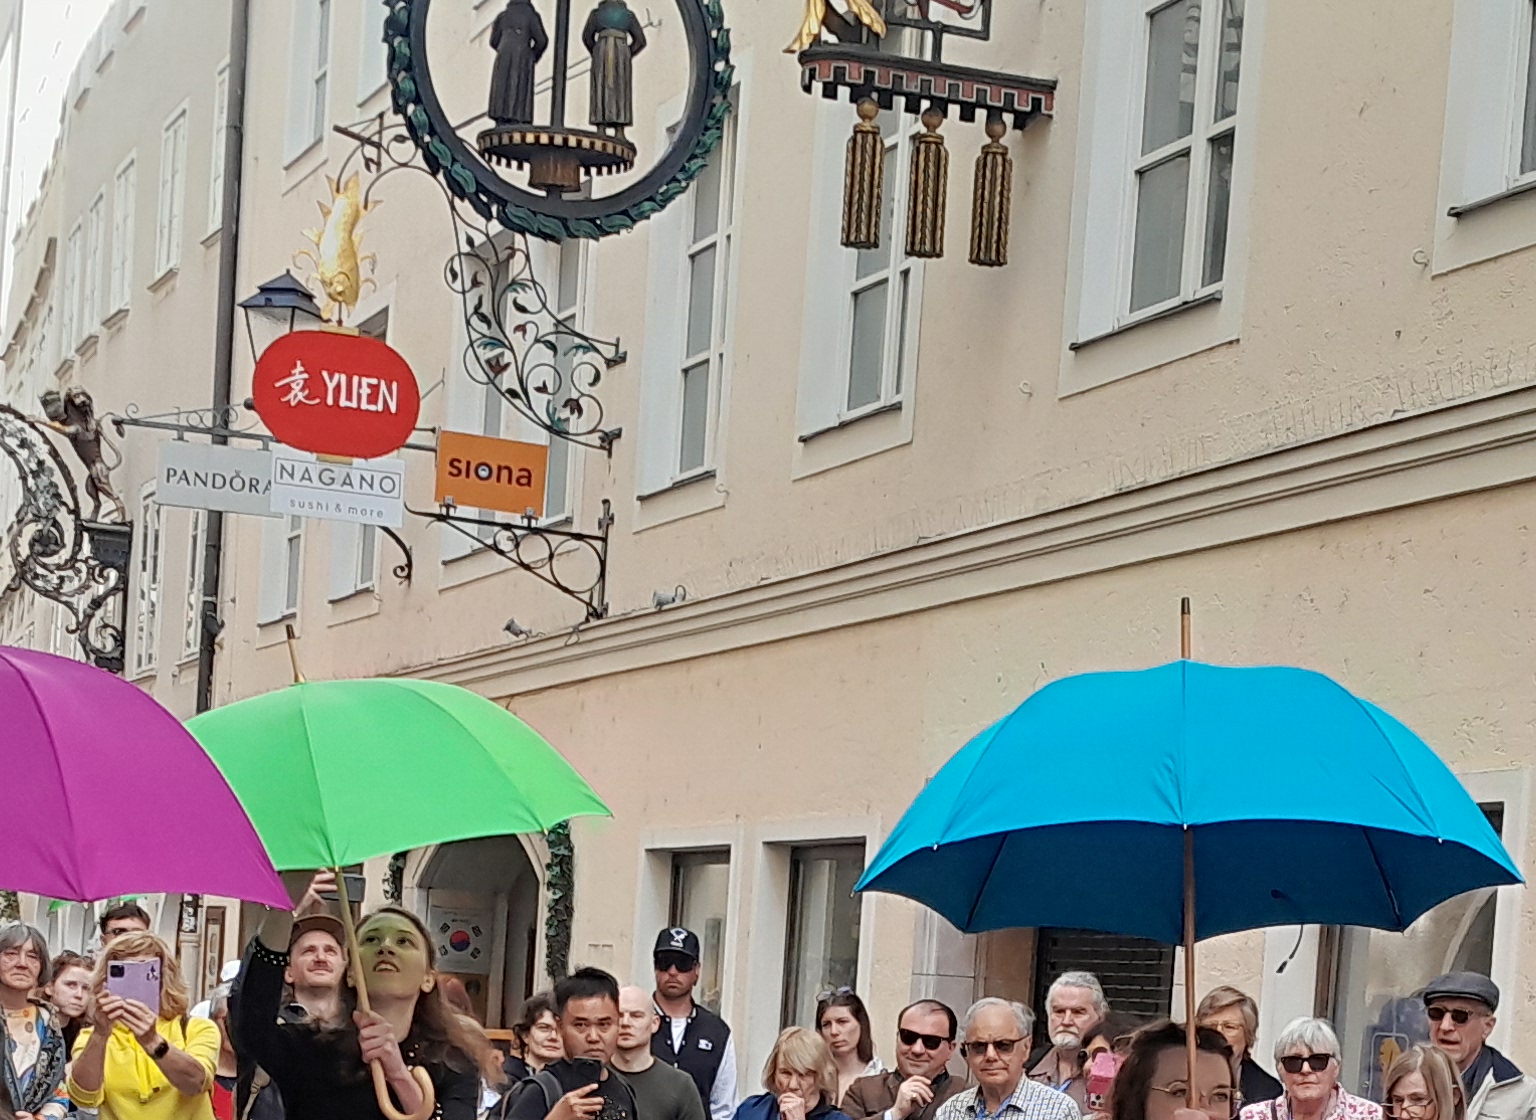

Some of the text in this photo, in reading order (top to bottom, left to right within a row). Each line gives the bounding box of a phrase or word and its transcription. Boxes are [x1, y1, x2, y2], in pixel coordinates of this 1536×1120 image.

[274, 360, 399, 414] 袁 YUEN
[279, 463, 397, 494] NAGANO
[447, 456, 533, 488] siona
[289, 499, 384, 519] sushi & more
